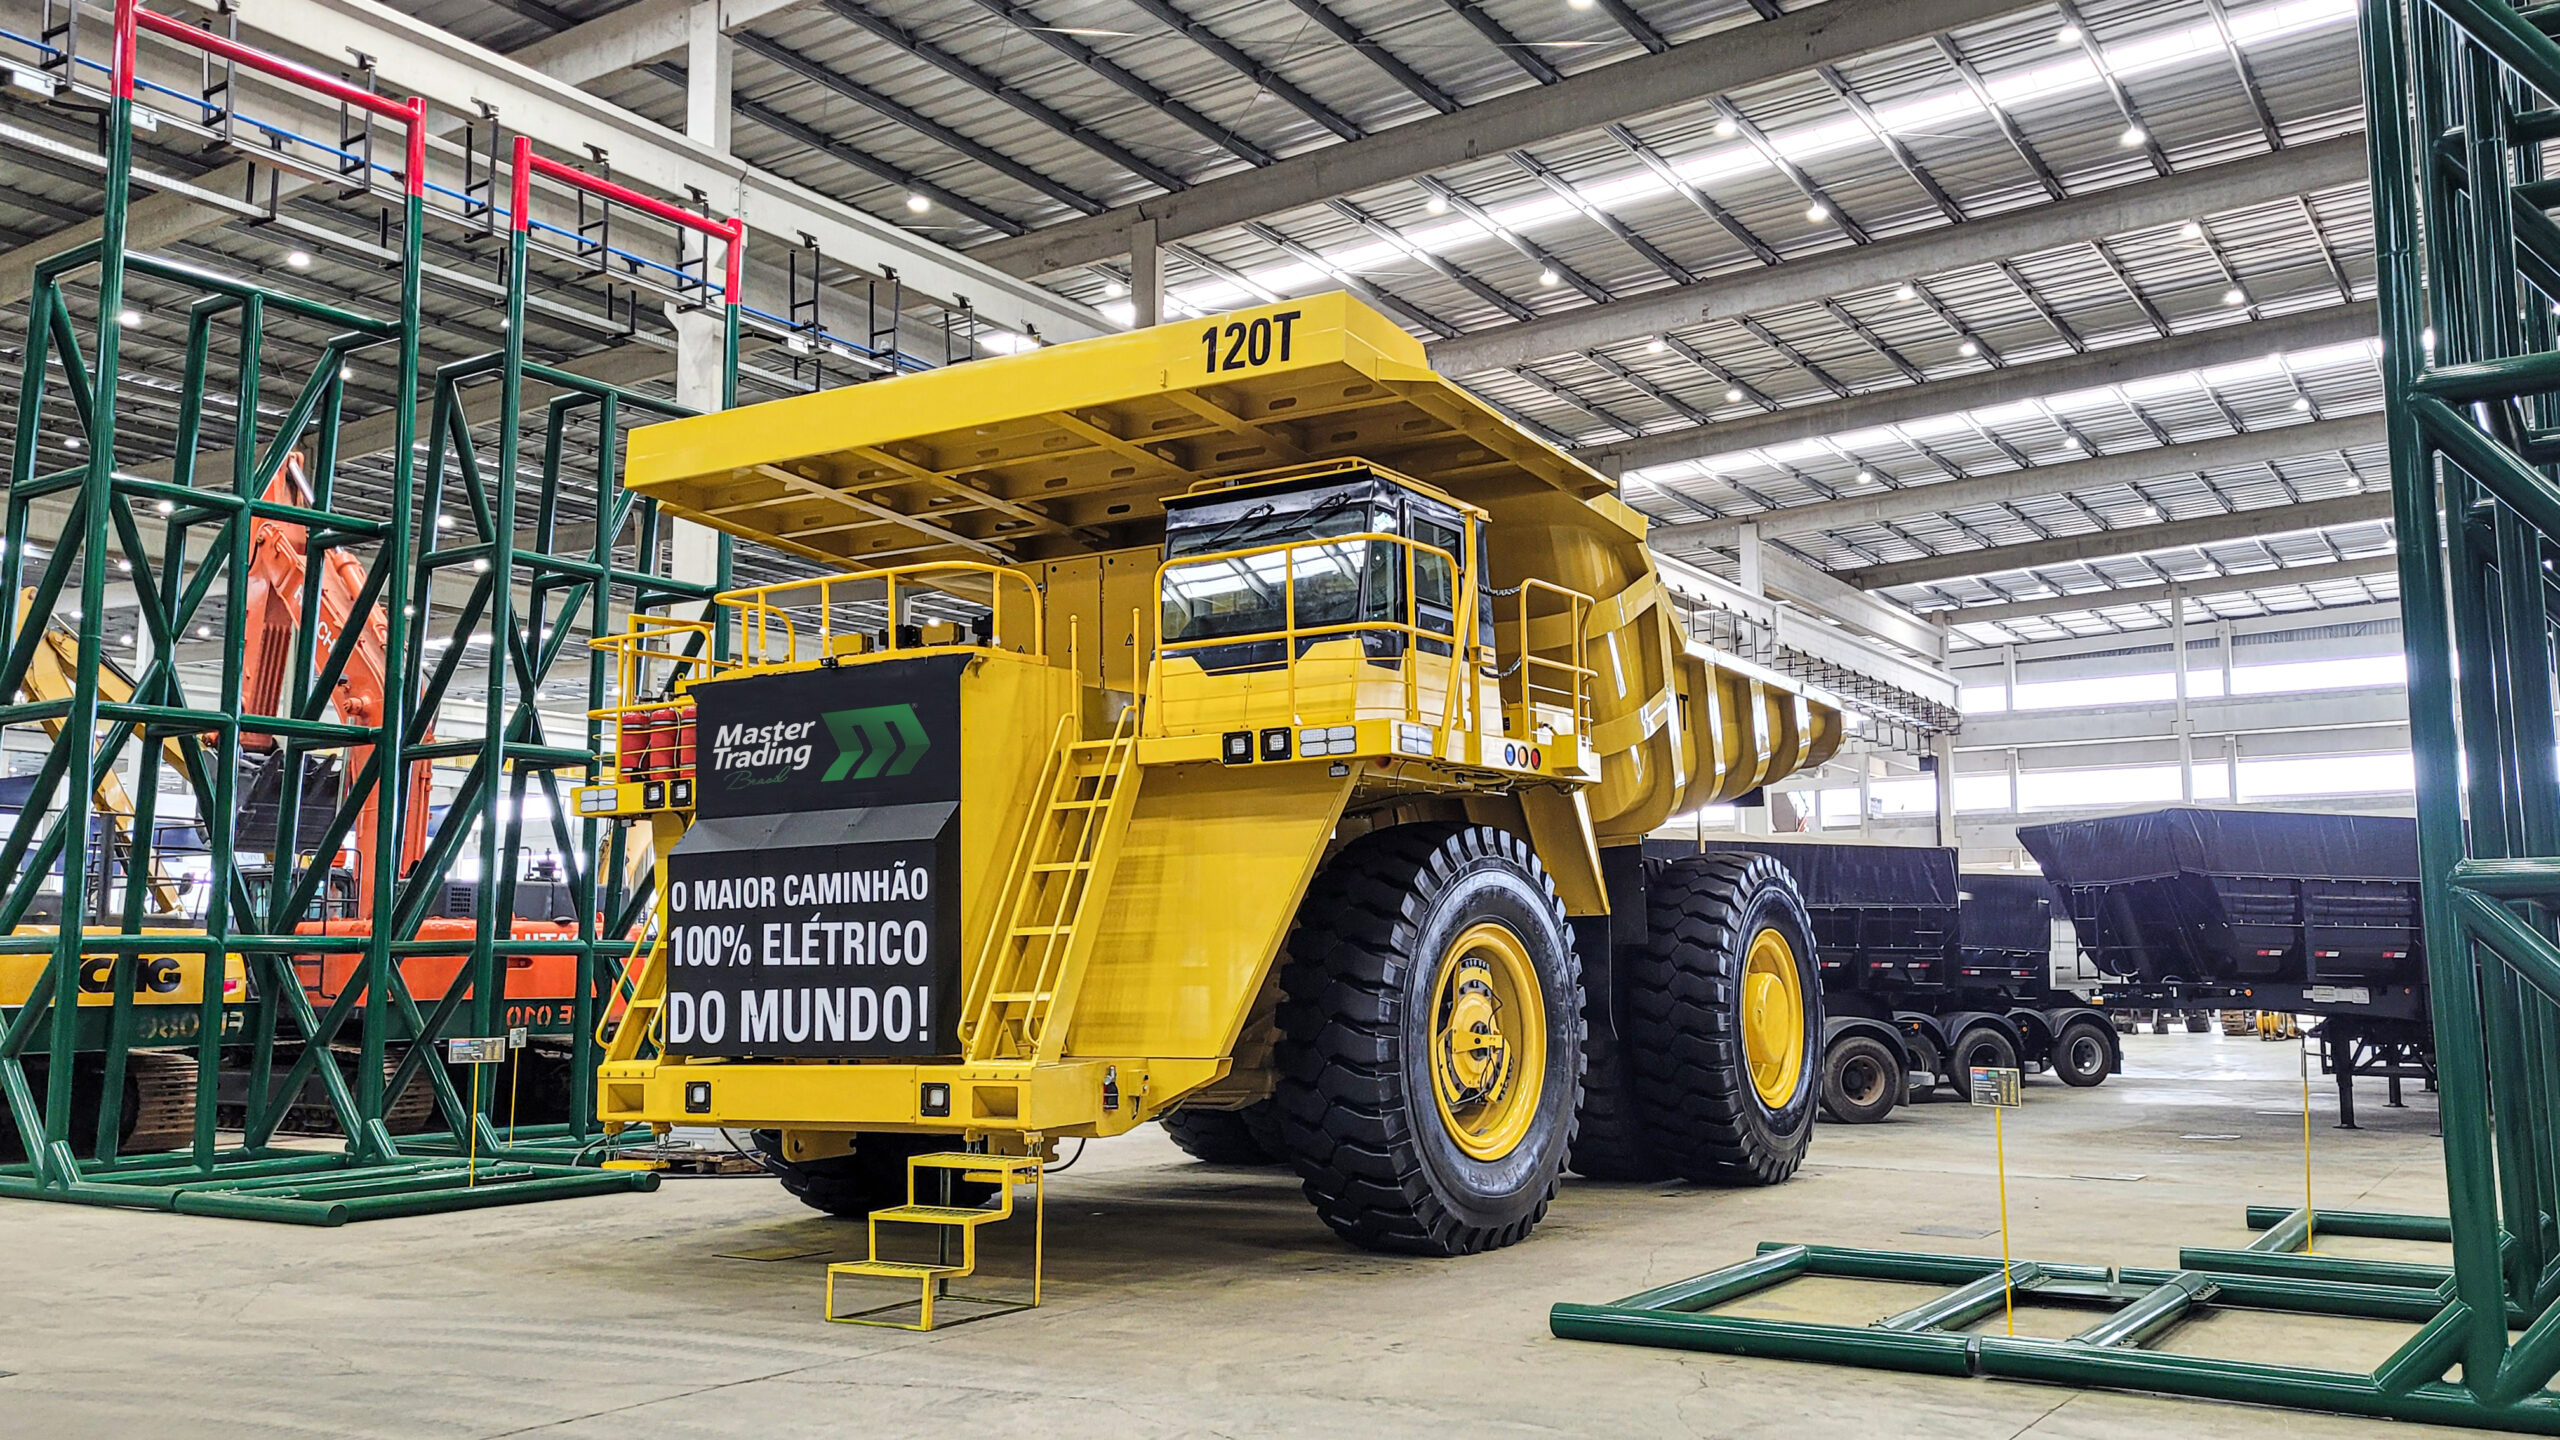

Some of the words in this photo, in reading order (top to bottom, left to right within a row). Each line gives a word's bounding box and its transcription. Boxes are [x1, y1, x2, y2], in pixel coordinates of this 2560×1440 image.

[1202, 310, 1301, 373] 120T
[713, 741, 812, 770] Trading
[714, 720, 816, 747] Master
[671, 881, 687, 912] O
[694, 876, 776, 911] MAIOR
[783, 860, 928, 906] CAMINHÃO
[670, 924, 751, 967] 100%
[763, 912, 928, 966] ELÉTRICO
[669, 990, 726, 1044] DO
[740, 986, 929, 1043] MUNDO!
